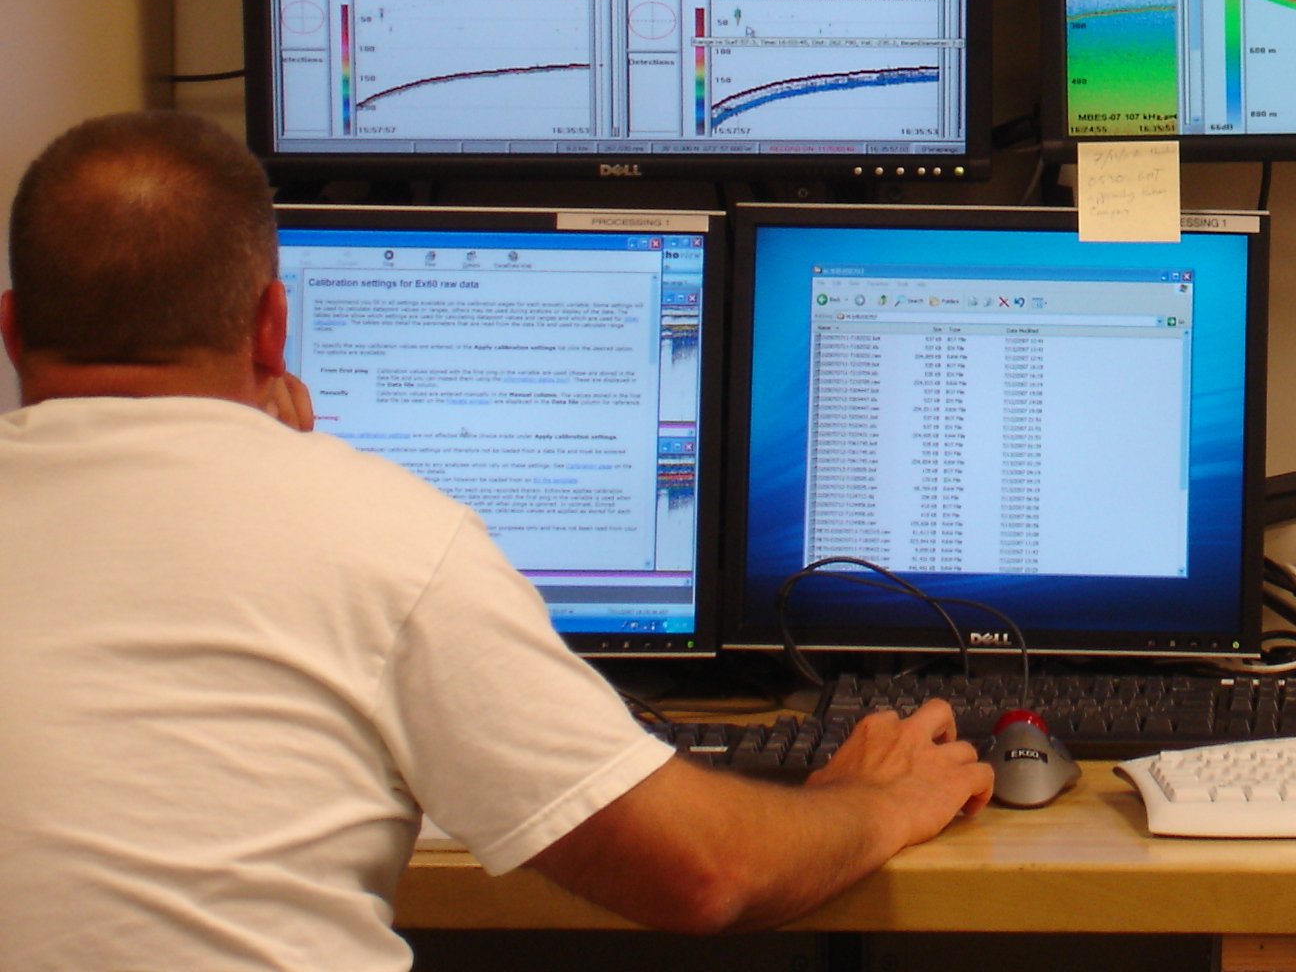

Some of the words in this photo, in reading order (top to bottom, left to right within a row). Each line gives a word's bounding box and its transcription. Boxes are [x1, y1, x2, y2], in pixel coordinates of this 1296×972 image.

[1125, 113, 1140, 121] 107
[600, 165, 642, 177] DELL
[591, 218, 662, 227] PROCESSING
[308, 278, 359, 288] Calibration
[361, 279, 397, 290] settings
[400, 280, 413, 288] for
[415, 280, 438, 289] Ex60
[440, 281, 457, 289] raw
[459, 281, 479, 289] data
[970, 632, 1012, 645] DELL
